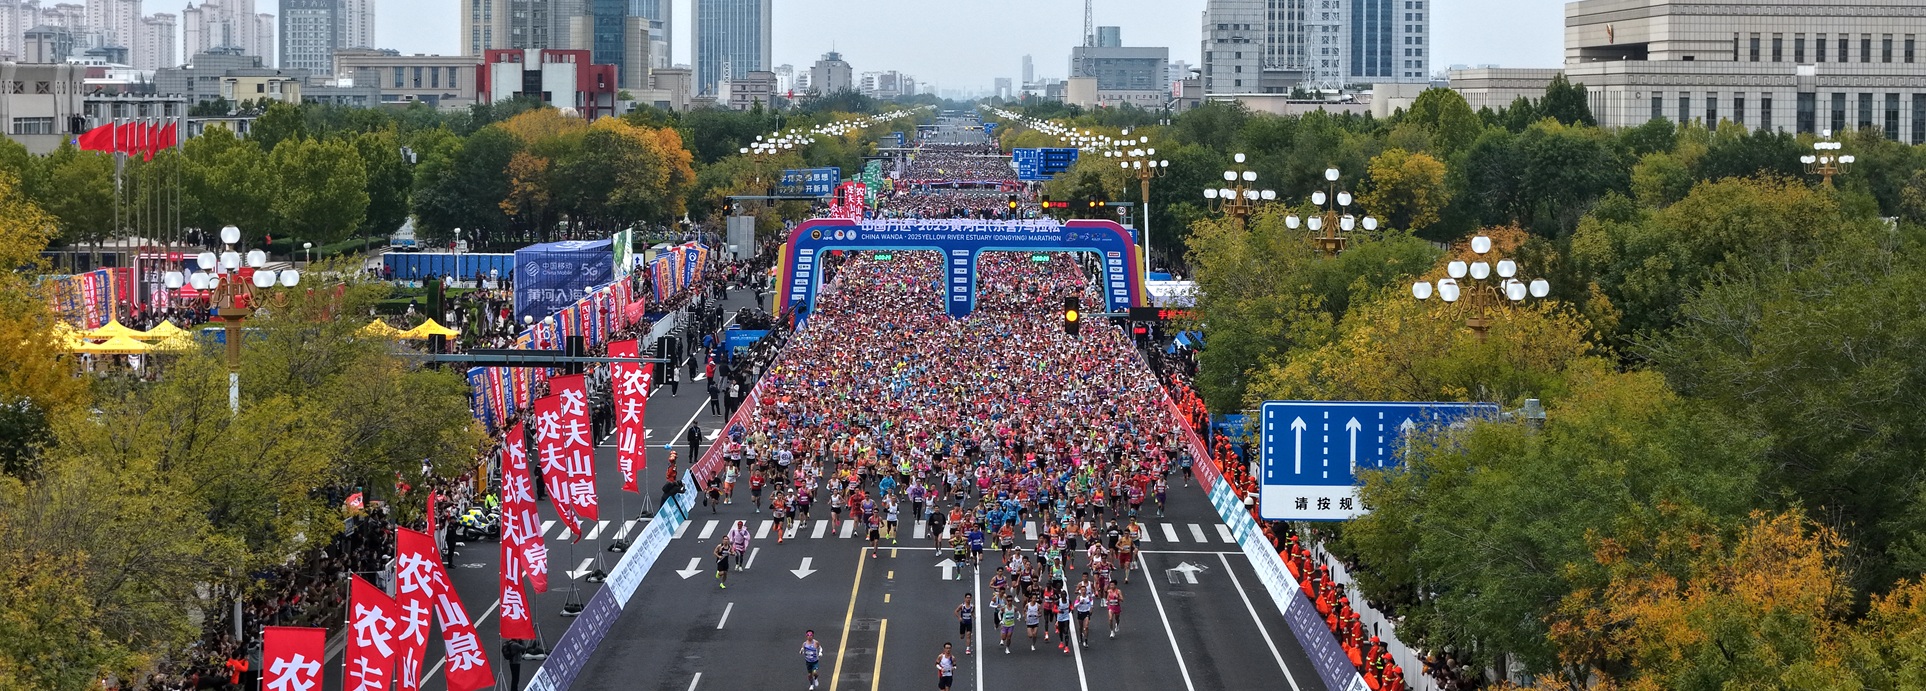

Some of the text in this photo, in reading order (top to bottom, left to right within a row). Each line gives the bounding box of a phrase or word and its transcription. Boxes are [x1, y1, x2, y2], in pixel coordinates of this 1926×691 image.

[805, 185, 829, 193] 开新局
[542, 261, 573, 270] 中国移动
[619, 369, 651, 483] 农夫山泉
[266, 652, 322, 691] 农
